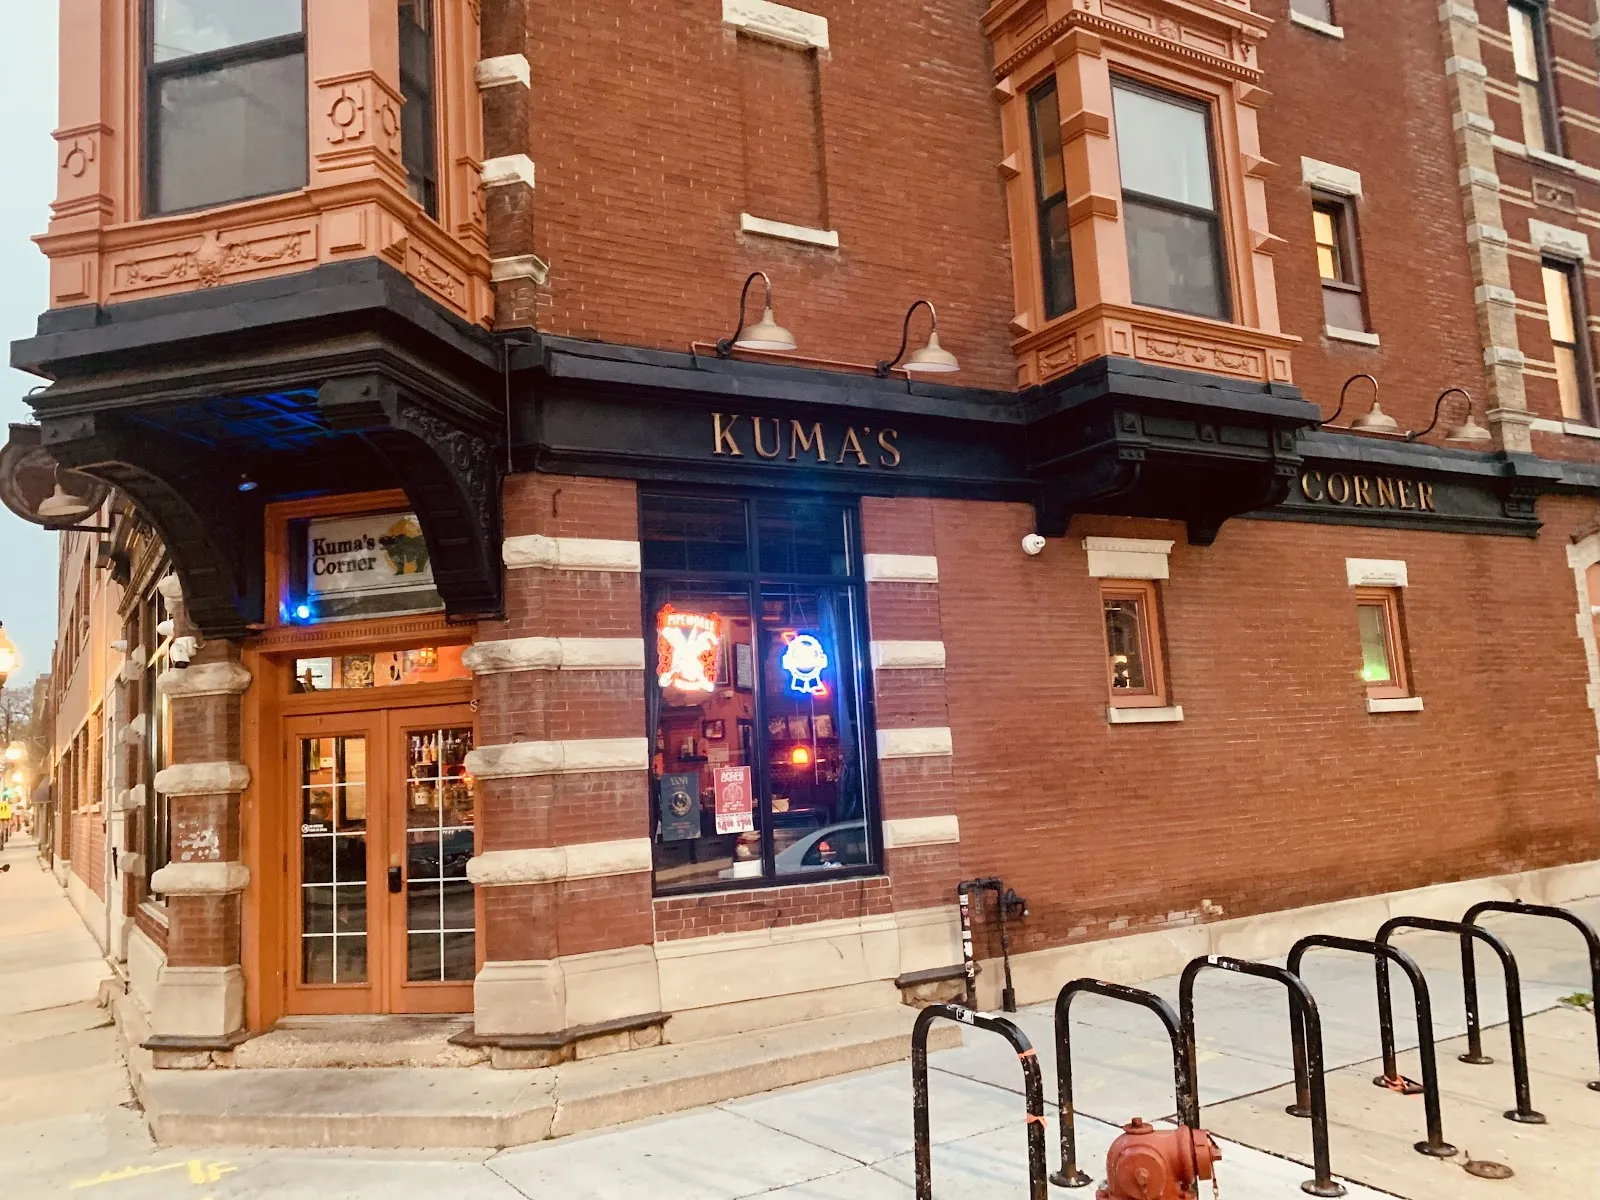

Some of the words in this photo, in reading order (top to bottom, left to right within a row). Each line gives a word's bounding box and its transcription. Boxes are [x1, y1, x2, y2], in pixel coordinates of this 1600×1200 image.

[710, 412, 901, 468] KUMA'S
[1301, 469, 1436, 512] CORNER
[312, 533, 375, 556] Kuma's
[313, 557, 377, 576] Corner
